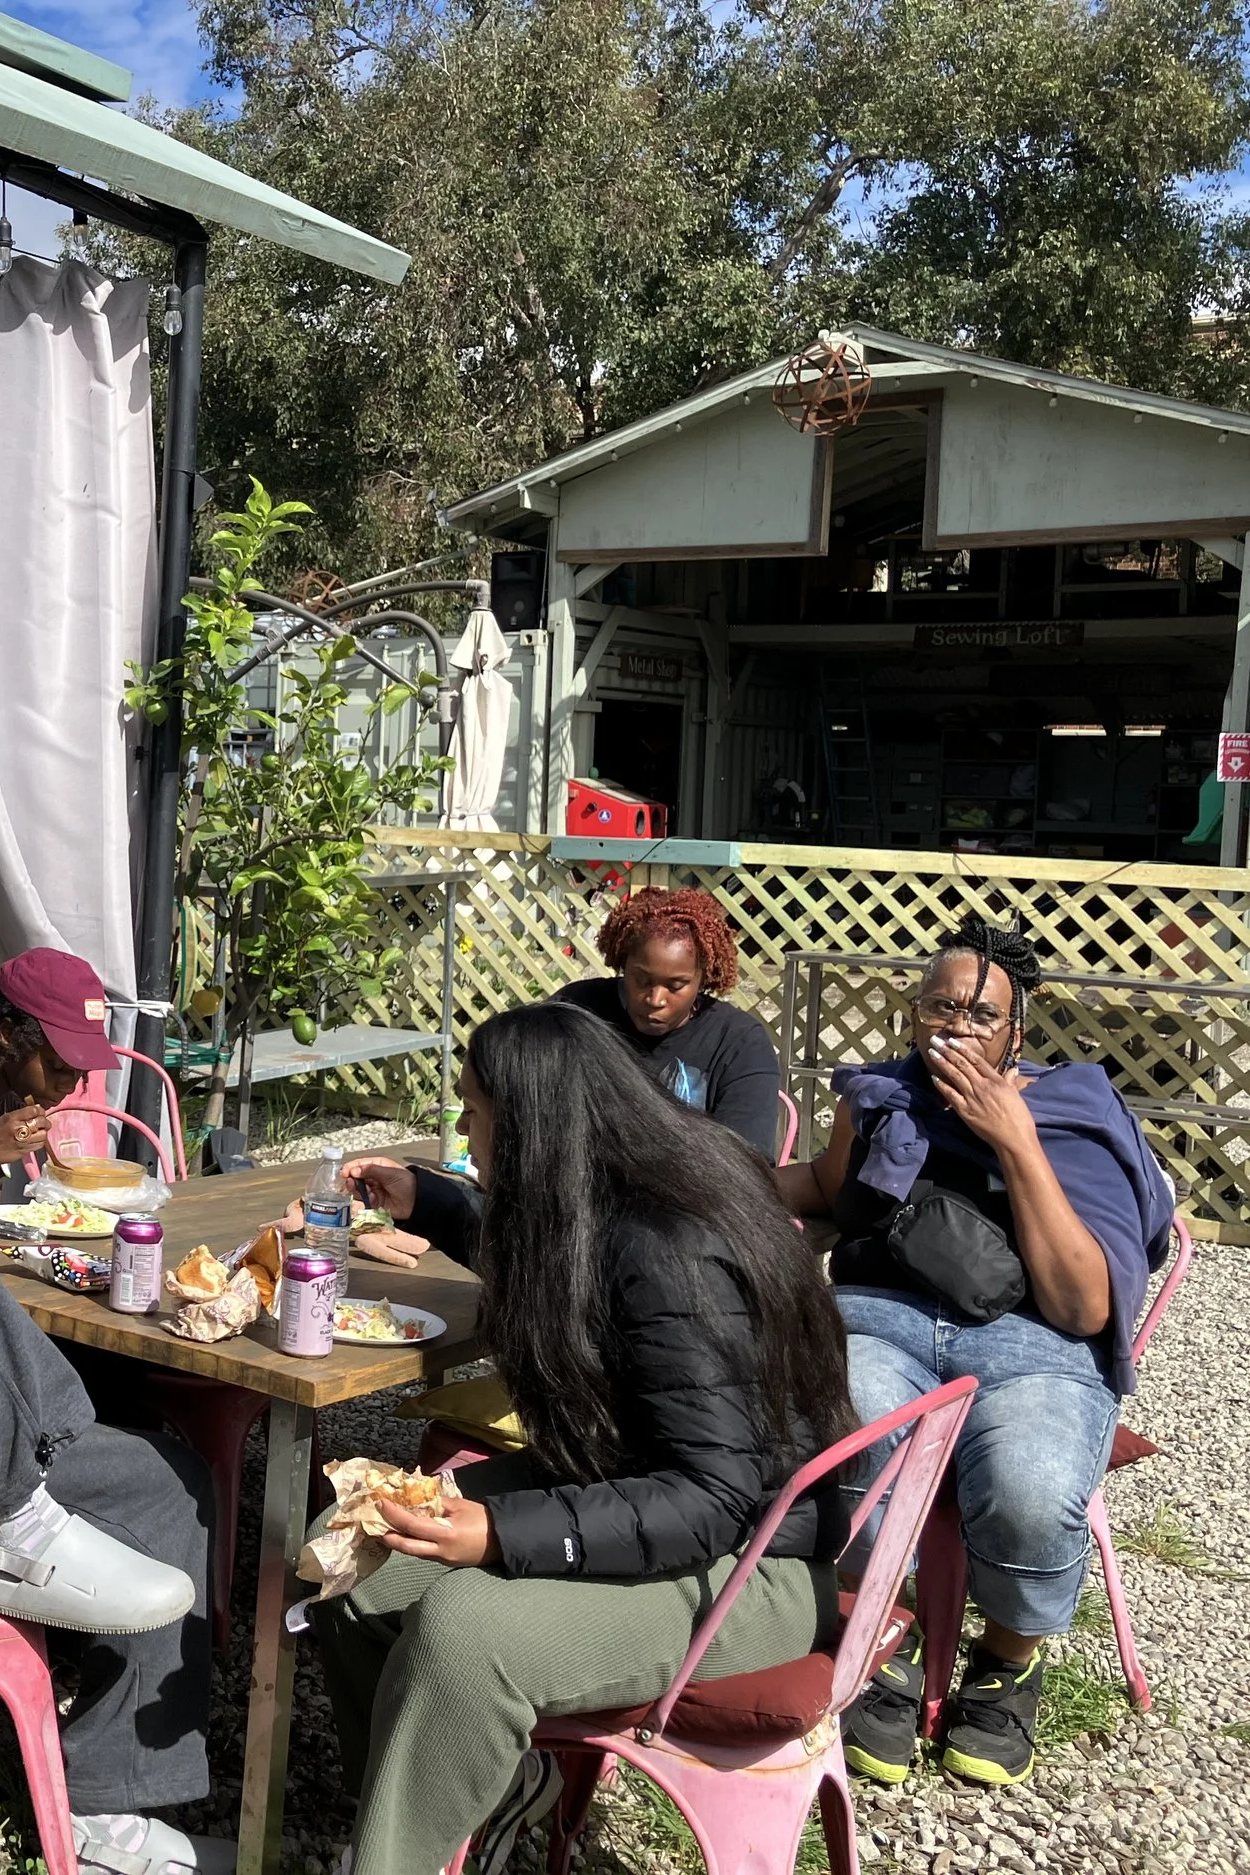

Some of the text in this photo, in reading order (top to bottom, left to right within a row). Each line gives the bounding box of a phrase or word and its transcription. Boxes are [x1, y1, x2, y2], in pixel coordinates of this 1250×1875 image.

[931, 625, 1067, 647] Sewing Loft
[628, 655, 654, 676] Metal
[1227, 740, 1248, 748] FIRE
[312, 1277, 337, 1301] WAT
